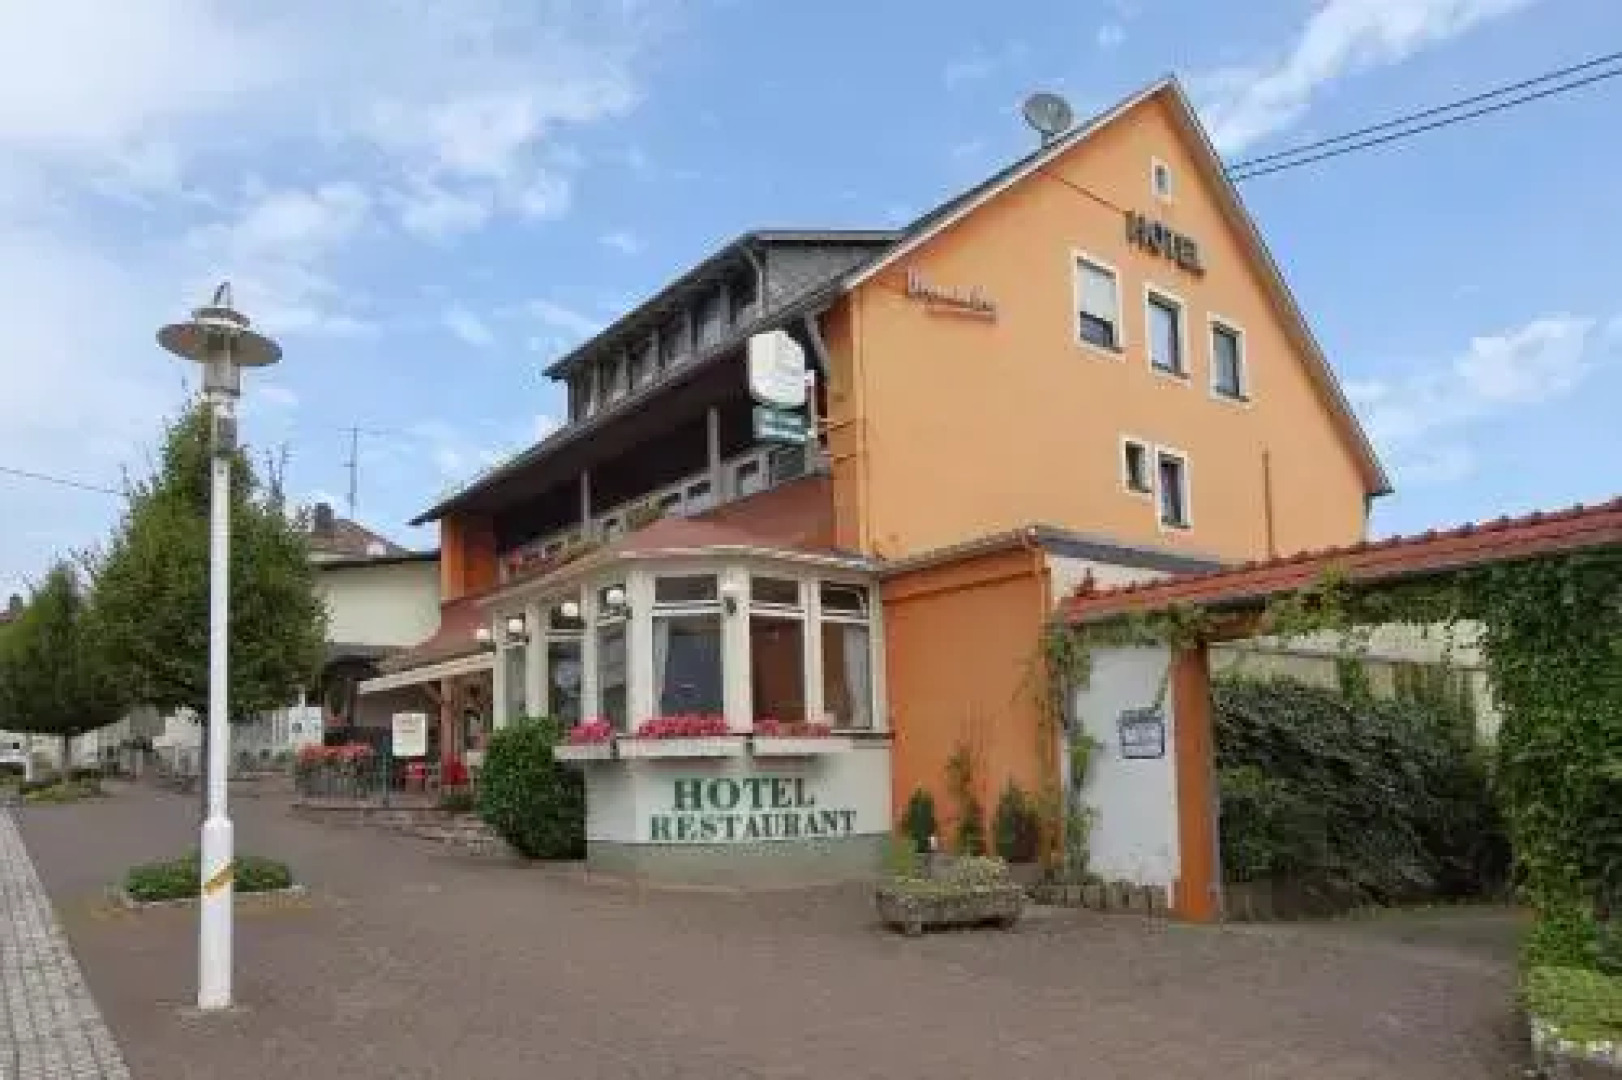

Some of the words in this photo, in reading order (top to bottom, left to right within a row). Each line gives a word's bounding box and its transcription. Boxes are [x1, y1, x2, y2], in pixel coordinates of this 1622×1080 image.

[1125, 210, 1206, 275] HOTEL
[673, 778, 816, 808] HOTEL
[651, 810, 857, 841] RESTAURANT
